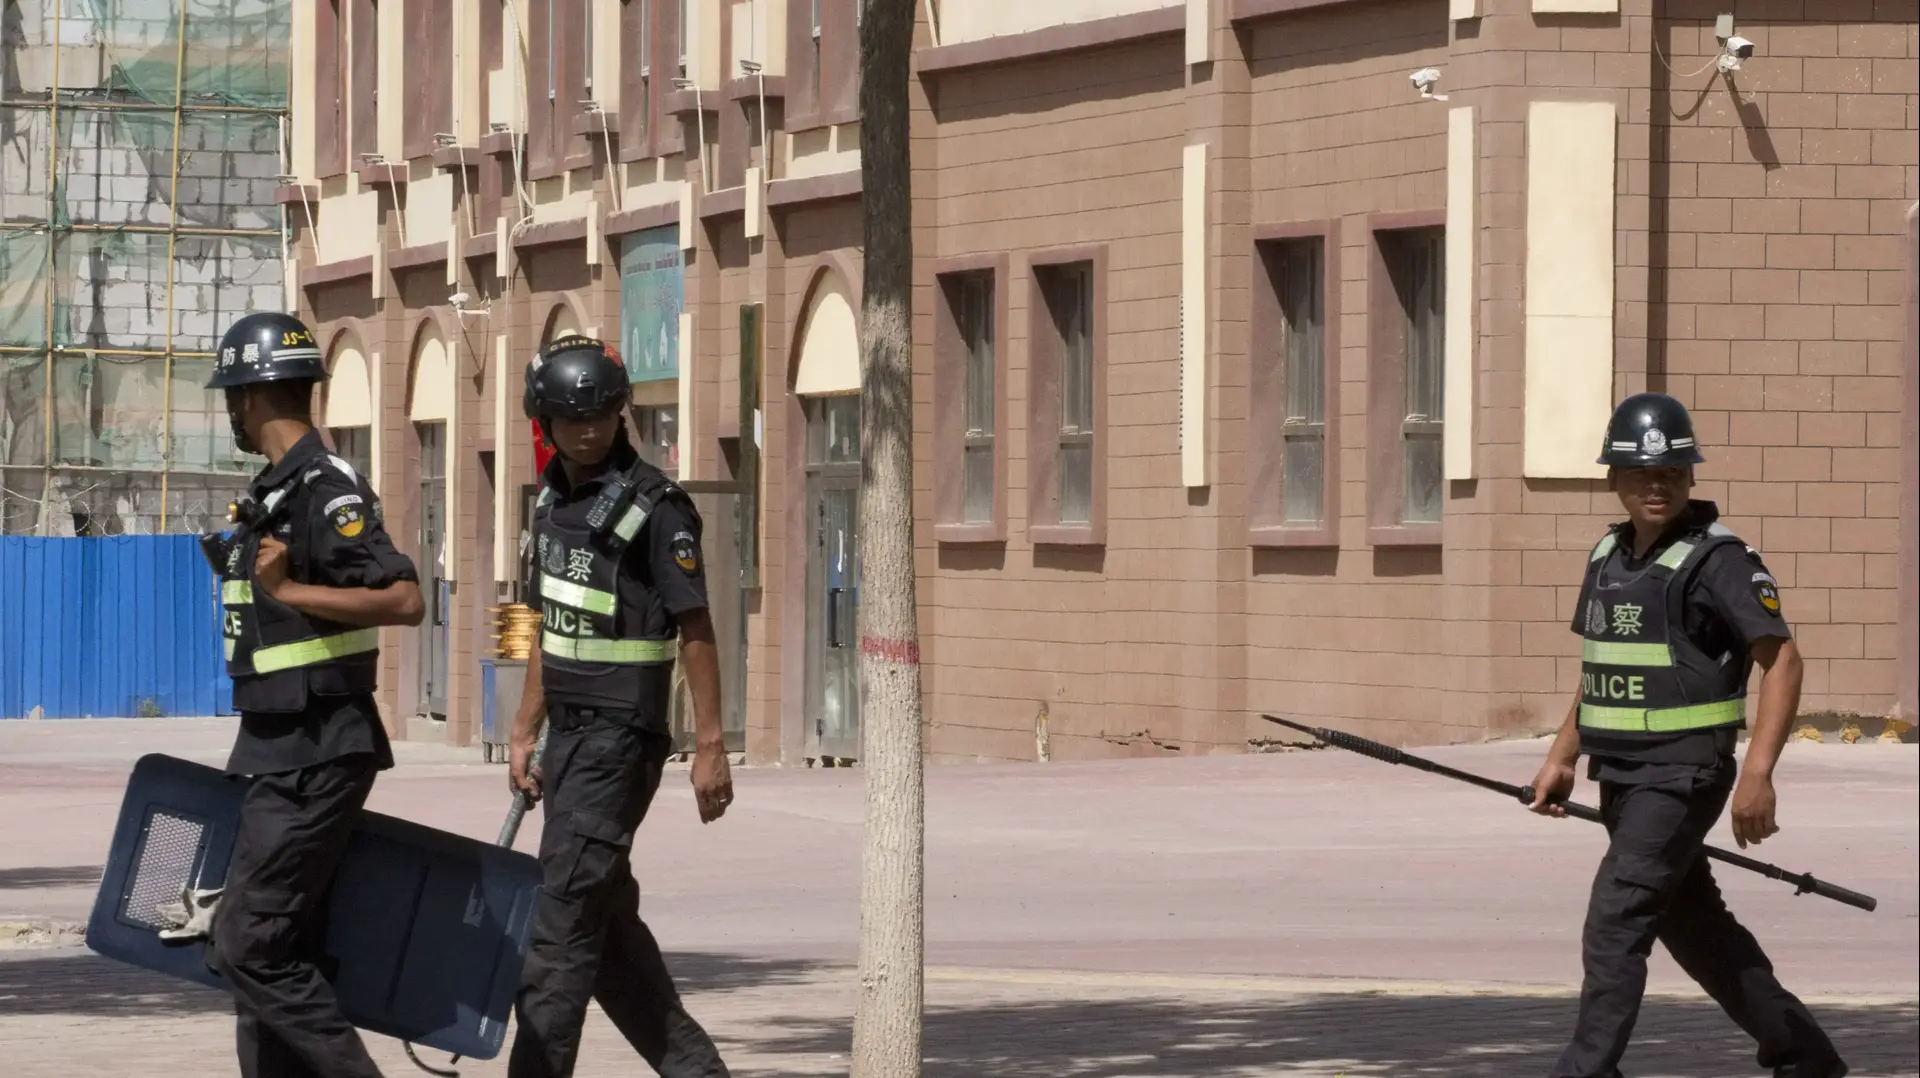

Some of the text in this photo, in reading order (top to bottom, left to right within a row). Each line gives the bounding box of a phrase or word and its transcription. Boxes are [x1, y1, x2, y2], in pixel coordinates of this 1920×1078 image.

[222, 343, 260, 367] 防暴
[549, 339, 600, 352] CHINA
[567, 547, 594, 582] 察
[542, 600, 594, 636] OLICE
[1612, 602, 1643, 635] 察
